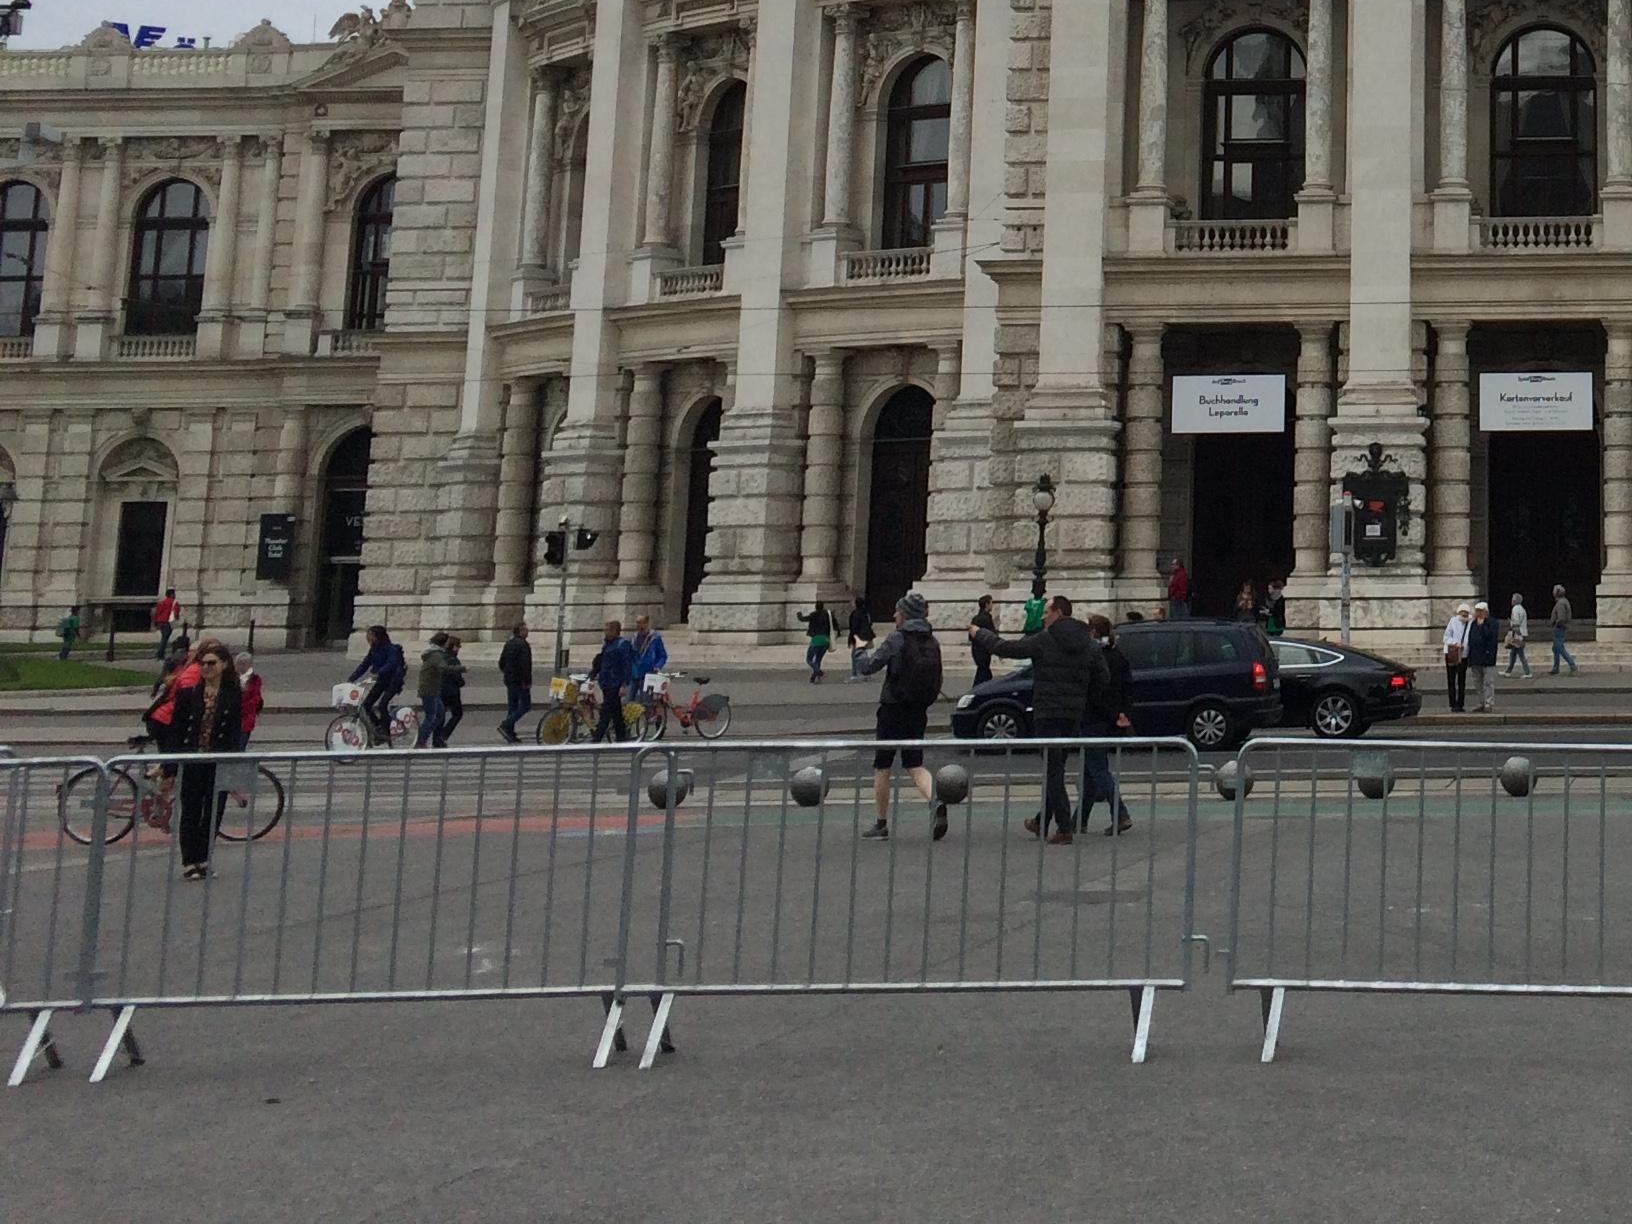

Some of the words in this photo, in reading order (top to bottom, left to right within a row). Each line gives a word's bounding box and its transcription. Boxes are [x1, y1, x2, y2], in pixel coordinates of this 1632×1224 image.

[1199, 394, 1259, 407] Buchhandlung
[1499, 392, 1573, 402] Kartenvorverkauf
[1208, 407, 1249, 418] Leporello
